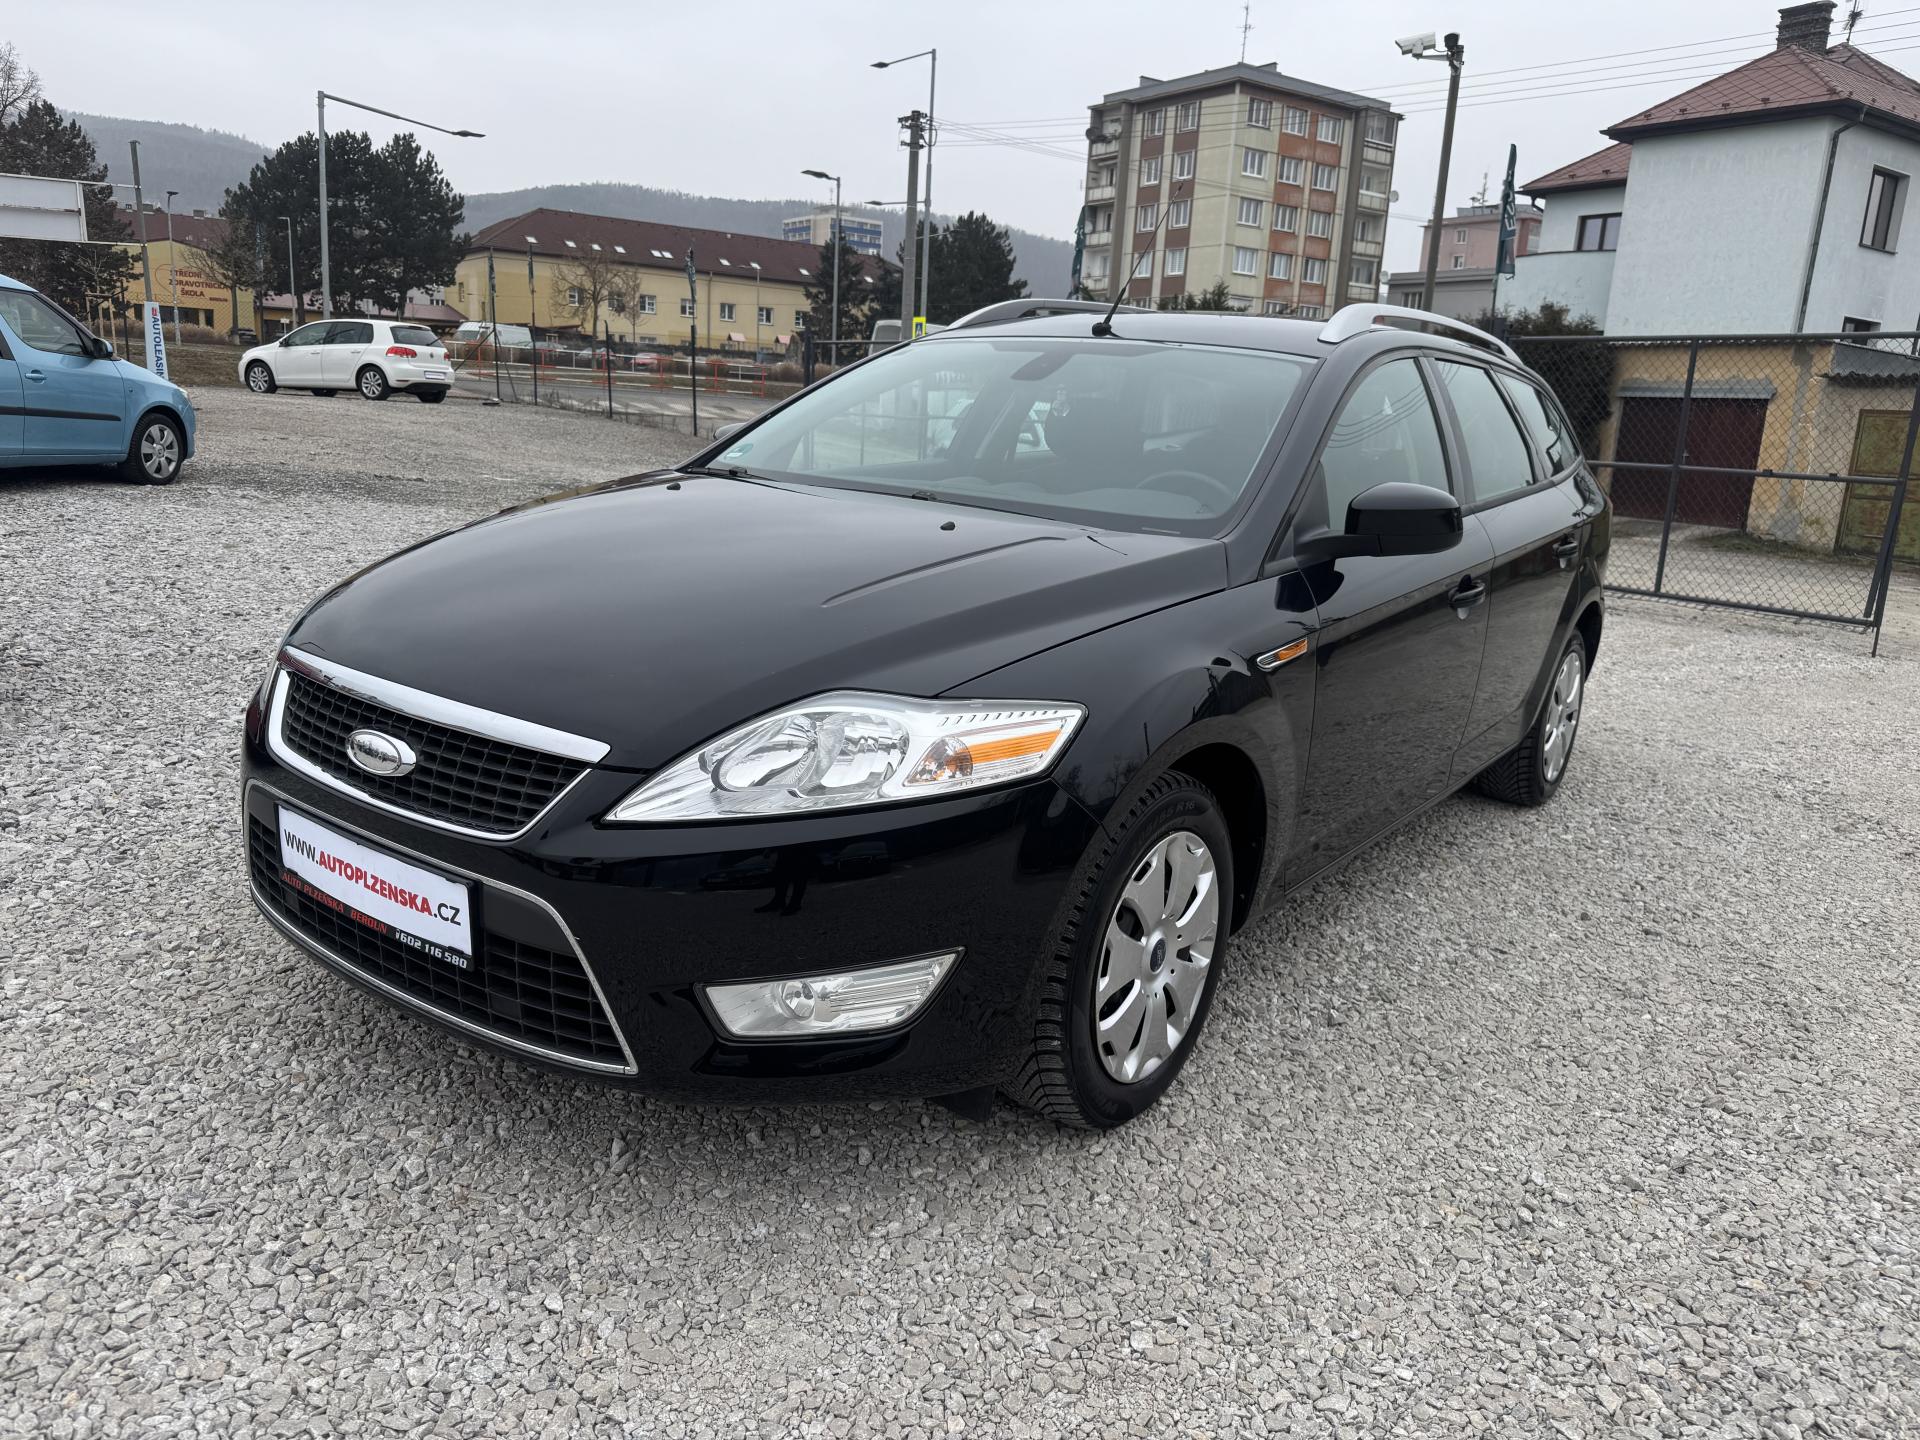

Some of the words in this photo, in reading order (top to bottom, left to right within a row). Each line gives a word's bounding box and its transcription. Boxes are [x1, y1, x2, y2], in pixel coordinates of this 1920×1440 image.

[180, 287, 205, 297] ŠKOLA
[284, 829, 461, 927] WWW.AUTOPLZENSKA.CZ
[282, 872, 300, 889] AUTO
[351, 910, 387, 934] BEROUN
[425, 944, 442, 959] 116
[444, 952, 468, 969] 580
